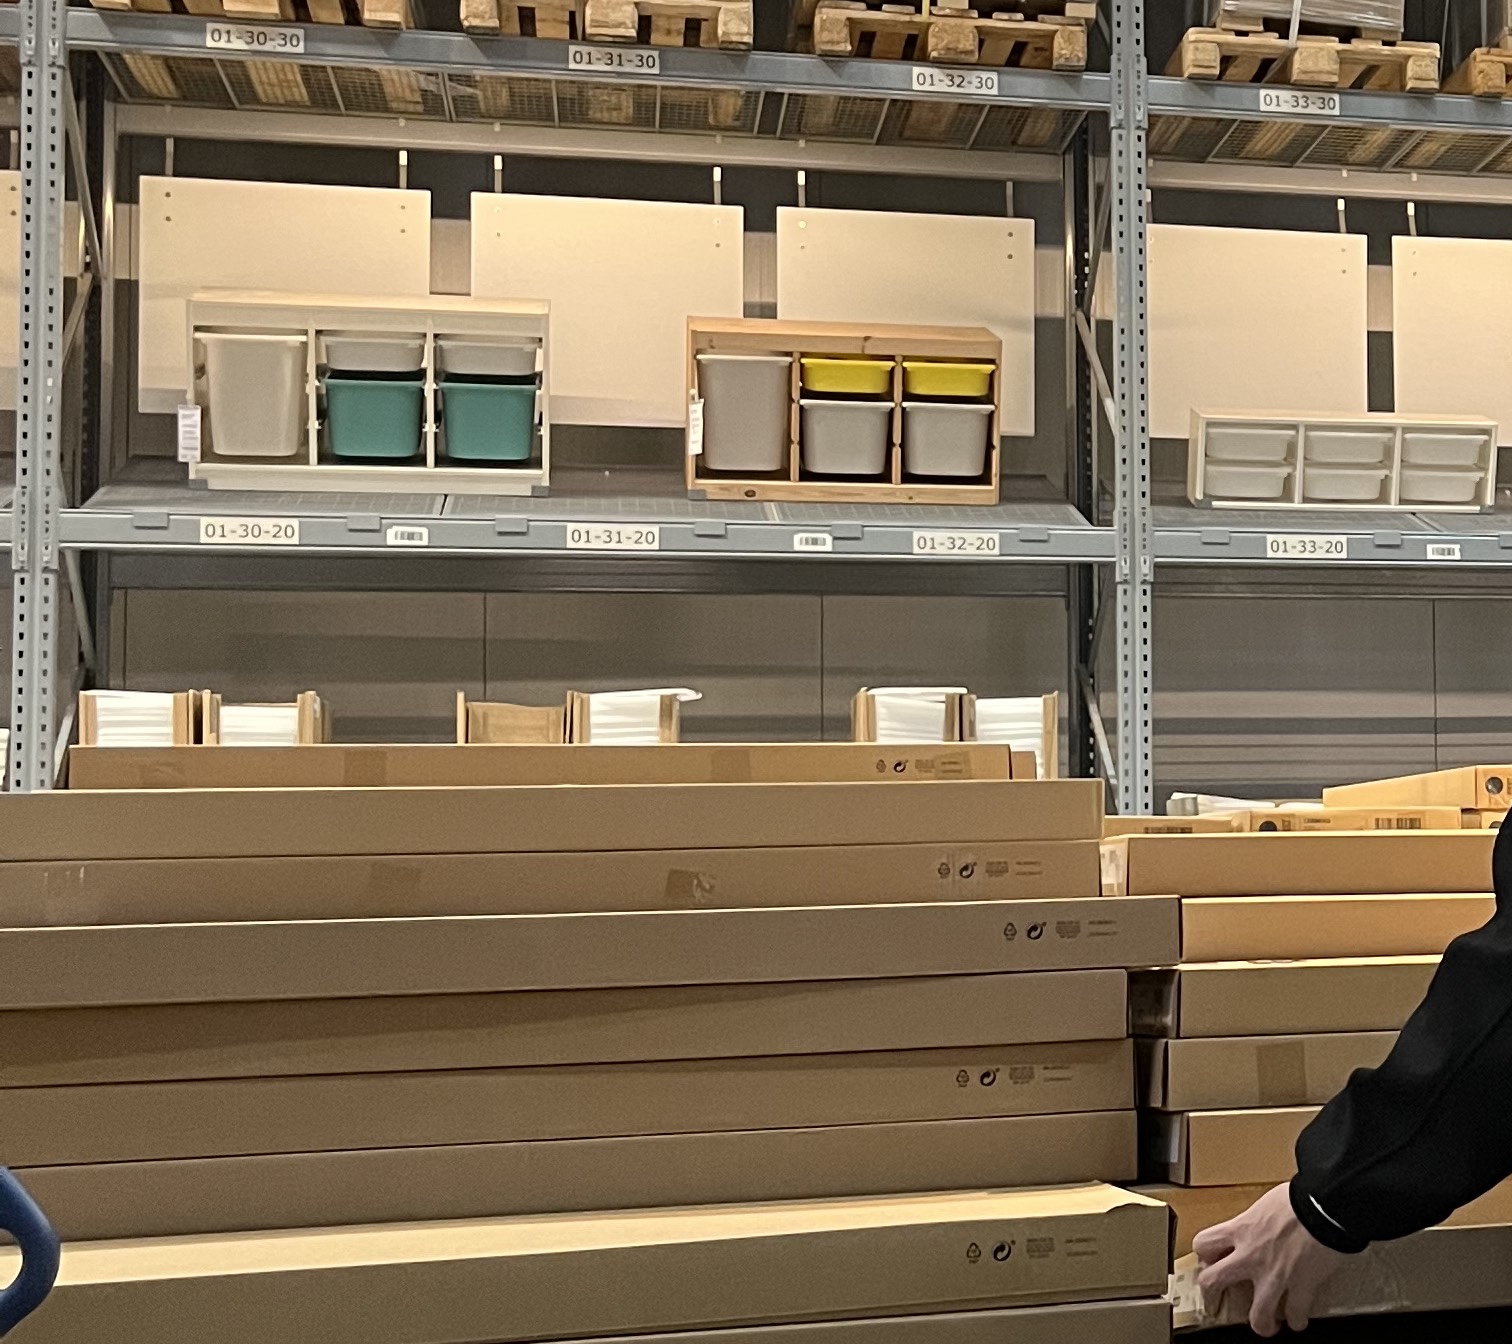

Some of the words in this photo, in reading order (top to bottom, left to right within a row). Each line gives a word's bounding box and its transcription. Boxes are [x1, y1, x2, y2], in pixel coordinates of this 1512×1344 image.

[211, 28, 300, 48] 01-30-30
[572, 50, 656, 69] 01-31-30
[916, 73, 994, 91] 01-32-30
[1262, 93, 1336, 111] 01-33-30
[204, 522, 296, 541] 01-30-20
[571, 528, 656, 547] 01-31-20
[916, 535, 996, 553] 01-32-20
[1269, 539, 1344, 556] 01-33-20
